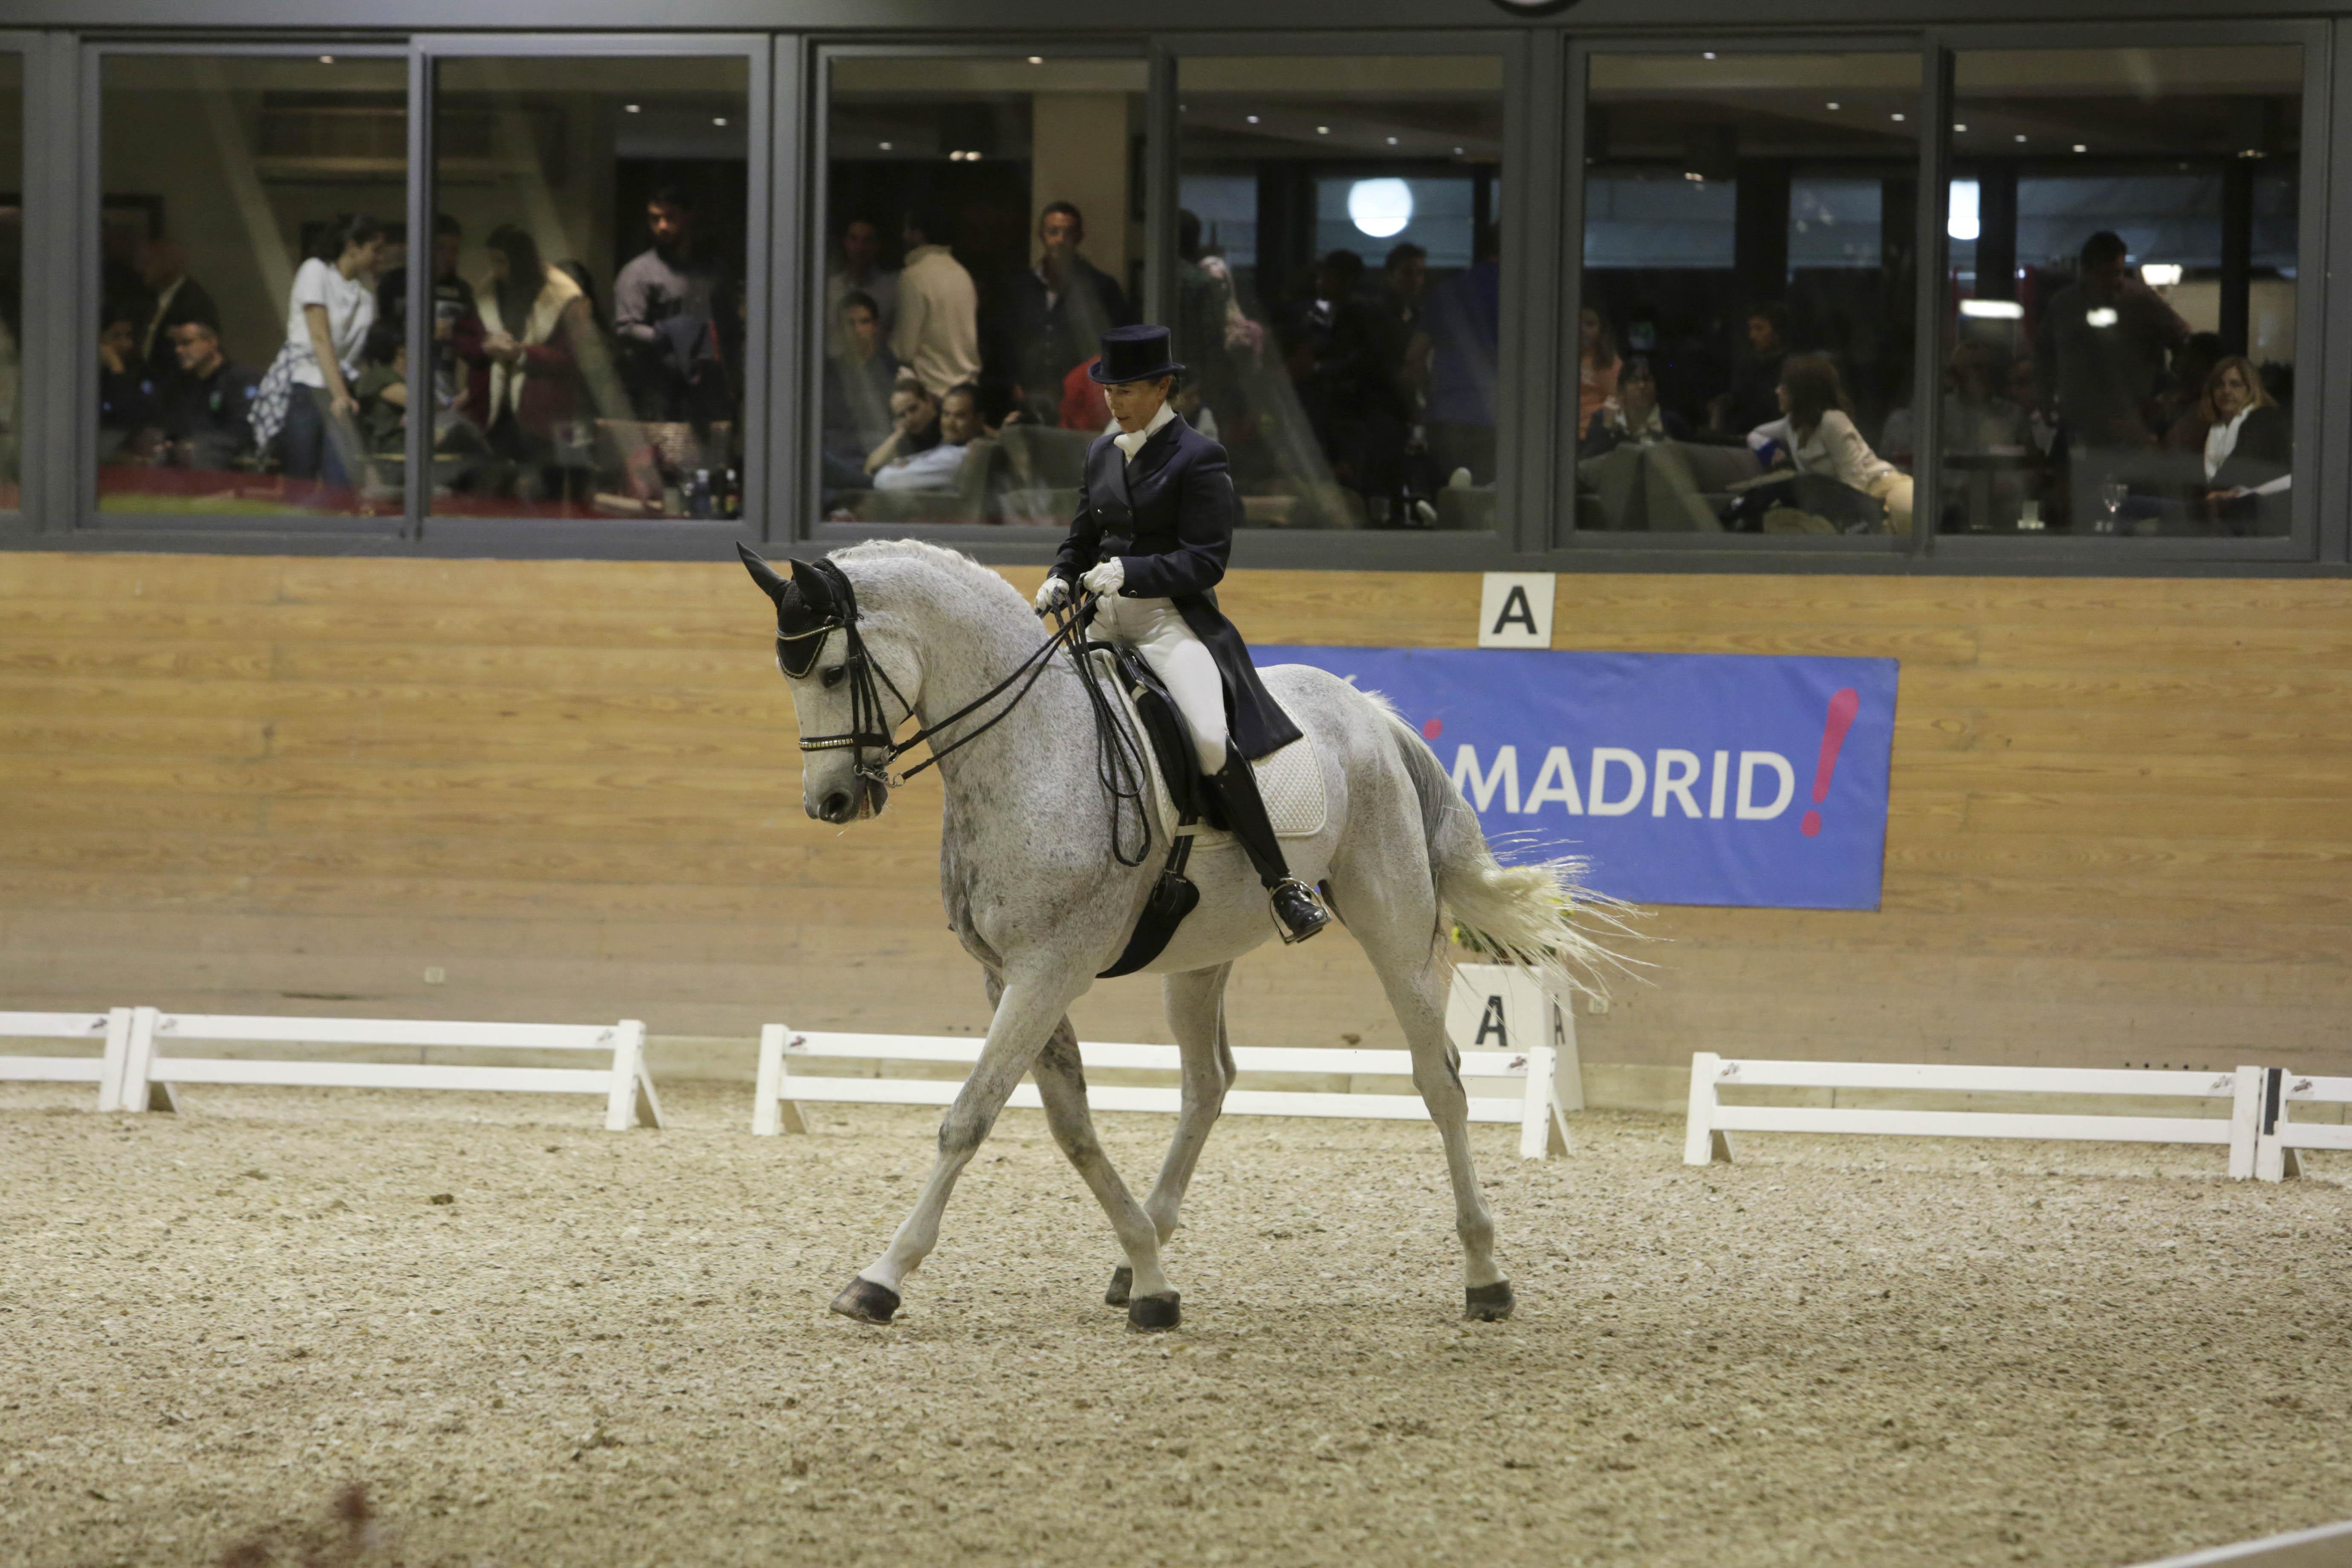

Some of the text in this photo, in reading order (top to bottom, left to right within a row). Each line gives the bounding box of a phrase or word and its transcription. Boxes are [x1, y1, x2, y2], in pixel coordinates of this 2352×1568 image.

[1492, 586, 1538, 635] A
[1422, 687, 1859, 838] MADRID!
[1474, 995, 1508, 1047] A
[1553, 993, 1566, 1045] A
